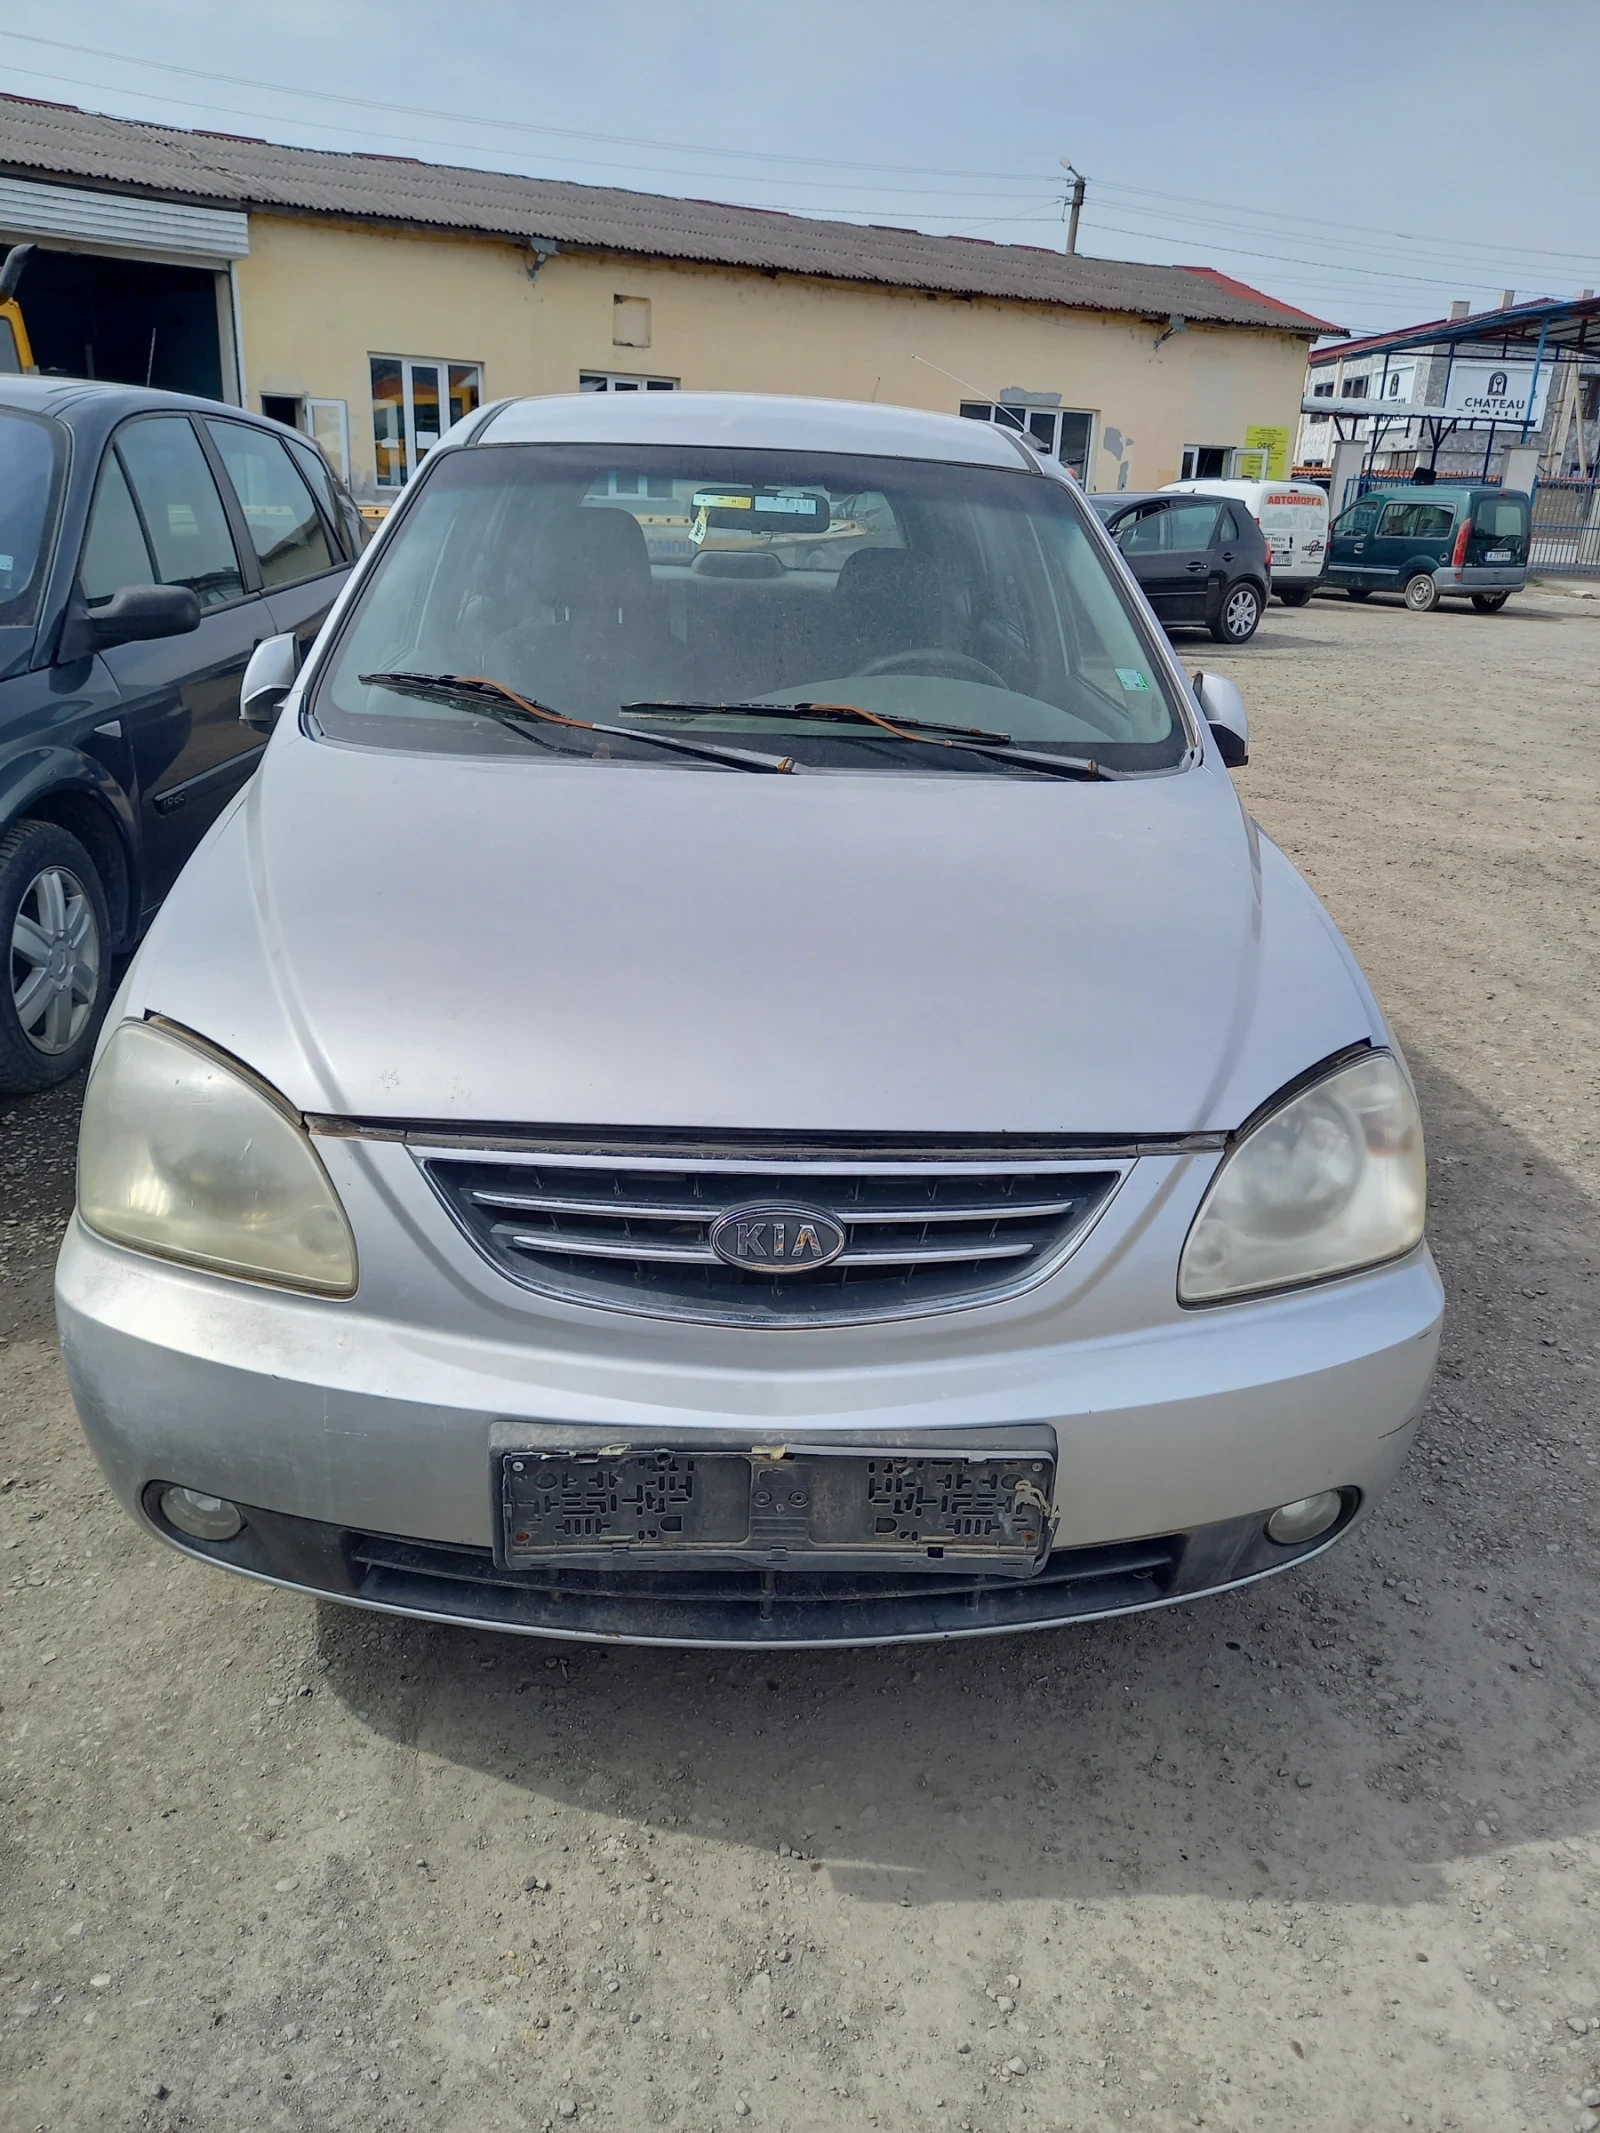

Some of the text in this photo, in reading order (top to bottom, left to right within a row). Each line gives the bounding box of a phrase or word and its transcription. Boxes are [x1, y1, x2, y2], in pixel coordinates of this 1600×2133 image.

[1464, 397, 1525, 409] CHATEAU
[1267, 496, 1322, 506] АВТОМОРГА
[735, 1222, 823, 1257] KIA
